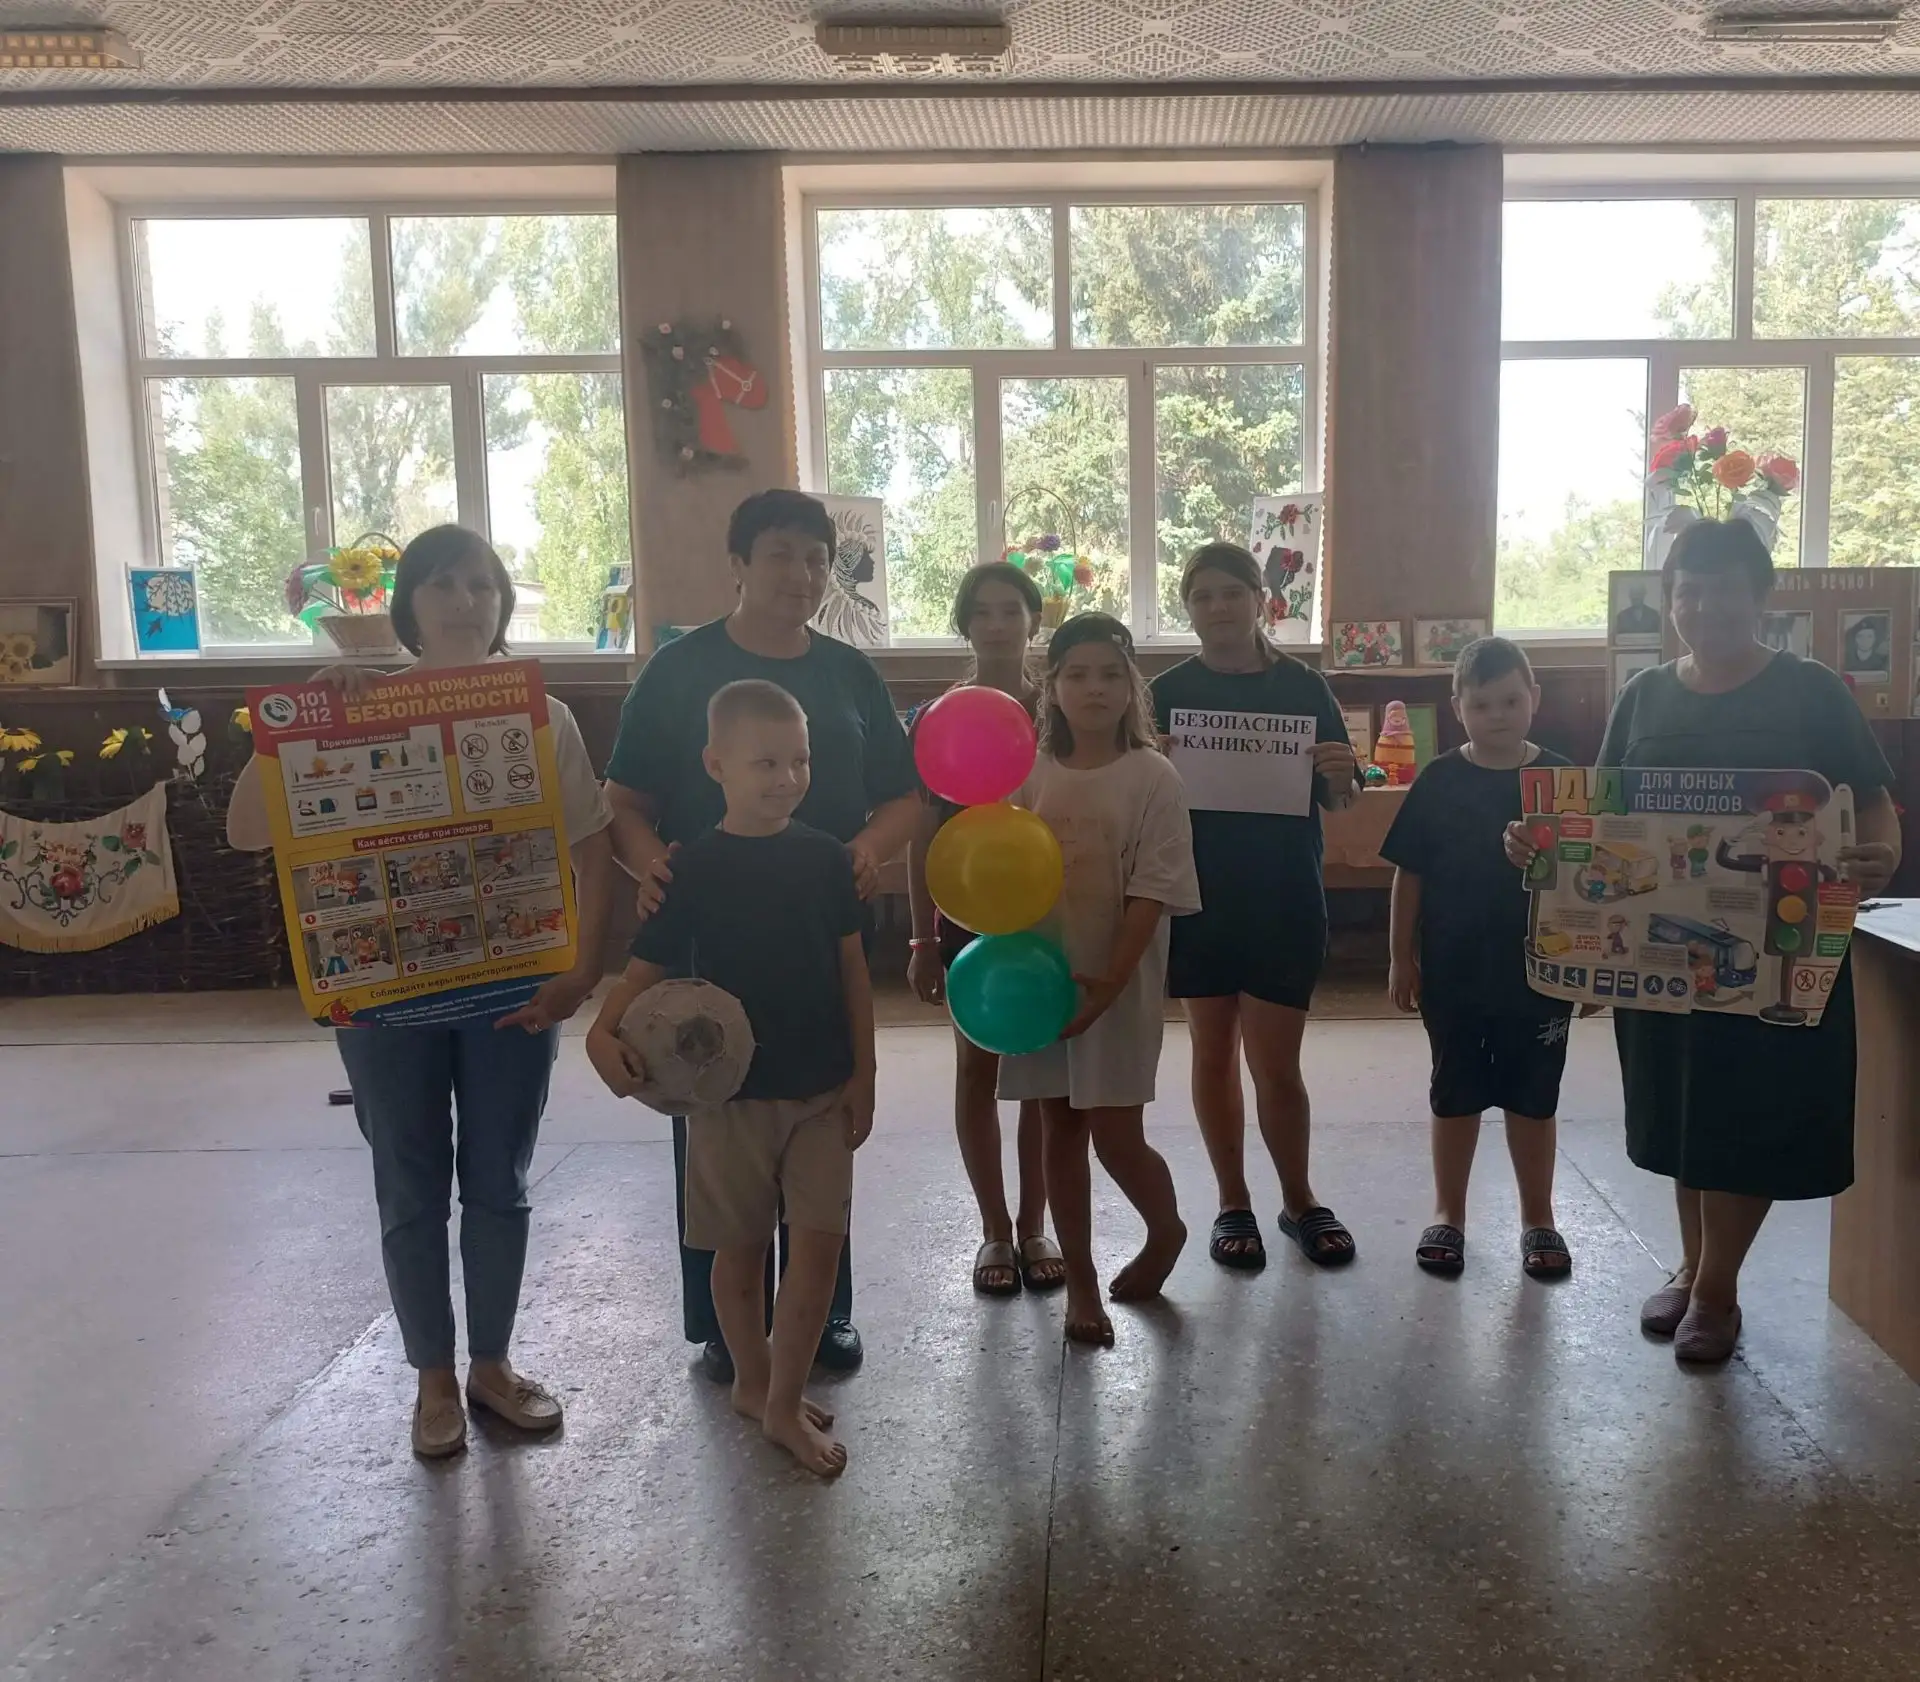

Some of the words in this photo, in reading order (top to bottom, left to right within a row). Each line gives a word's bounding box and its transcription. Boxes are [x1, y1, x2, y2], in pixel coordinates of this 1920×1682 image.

[428, 668, 527, 694] ПОЖАРНОЙ
[297, 691, 328, 708] 101
[345, 687, 529, 724] БЕЗОПАСНОСТИ
[300, 707, 332, 724] 112
[1173, 711, 1312, 735] БЕЗОПАСНЫЕ
[322, 737, 365, 749] Причины
[1183, 733, 1299, 756] КАНИКУЛЫ
[1521, 768, 1628, 815] ПДД
[1639, 772, 1673, 791] ДЛЯ
[1679, 772, 1736, 791] ЮНЫХ
[1634, 792, 1743, 814] ПЕШЕХОДОВ
[357, 838, 376, 850] Как
[377, 834, 406, 847] вести
[407, 830, 430, 842] себя
[432, 827, 451, 840] при
[370, 982, 425, 999] Соблюдайте
